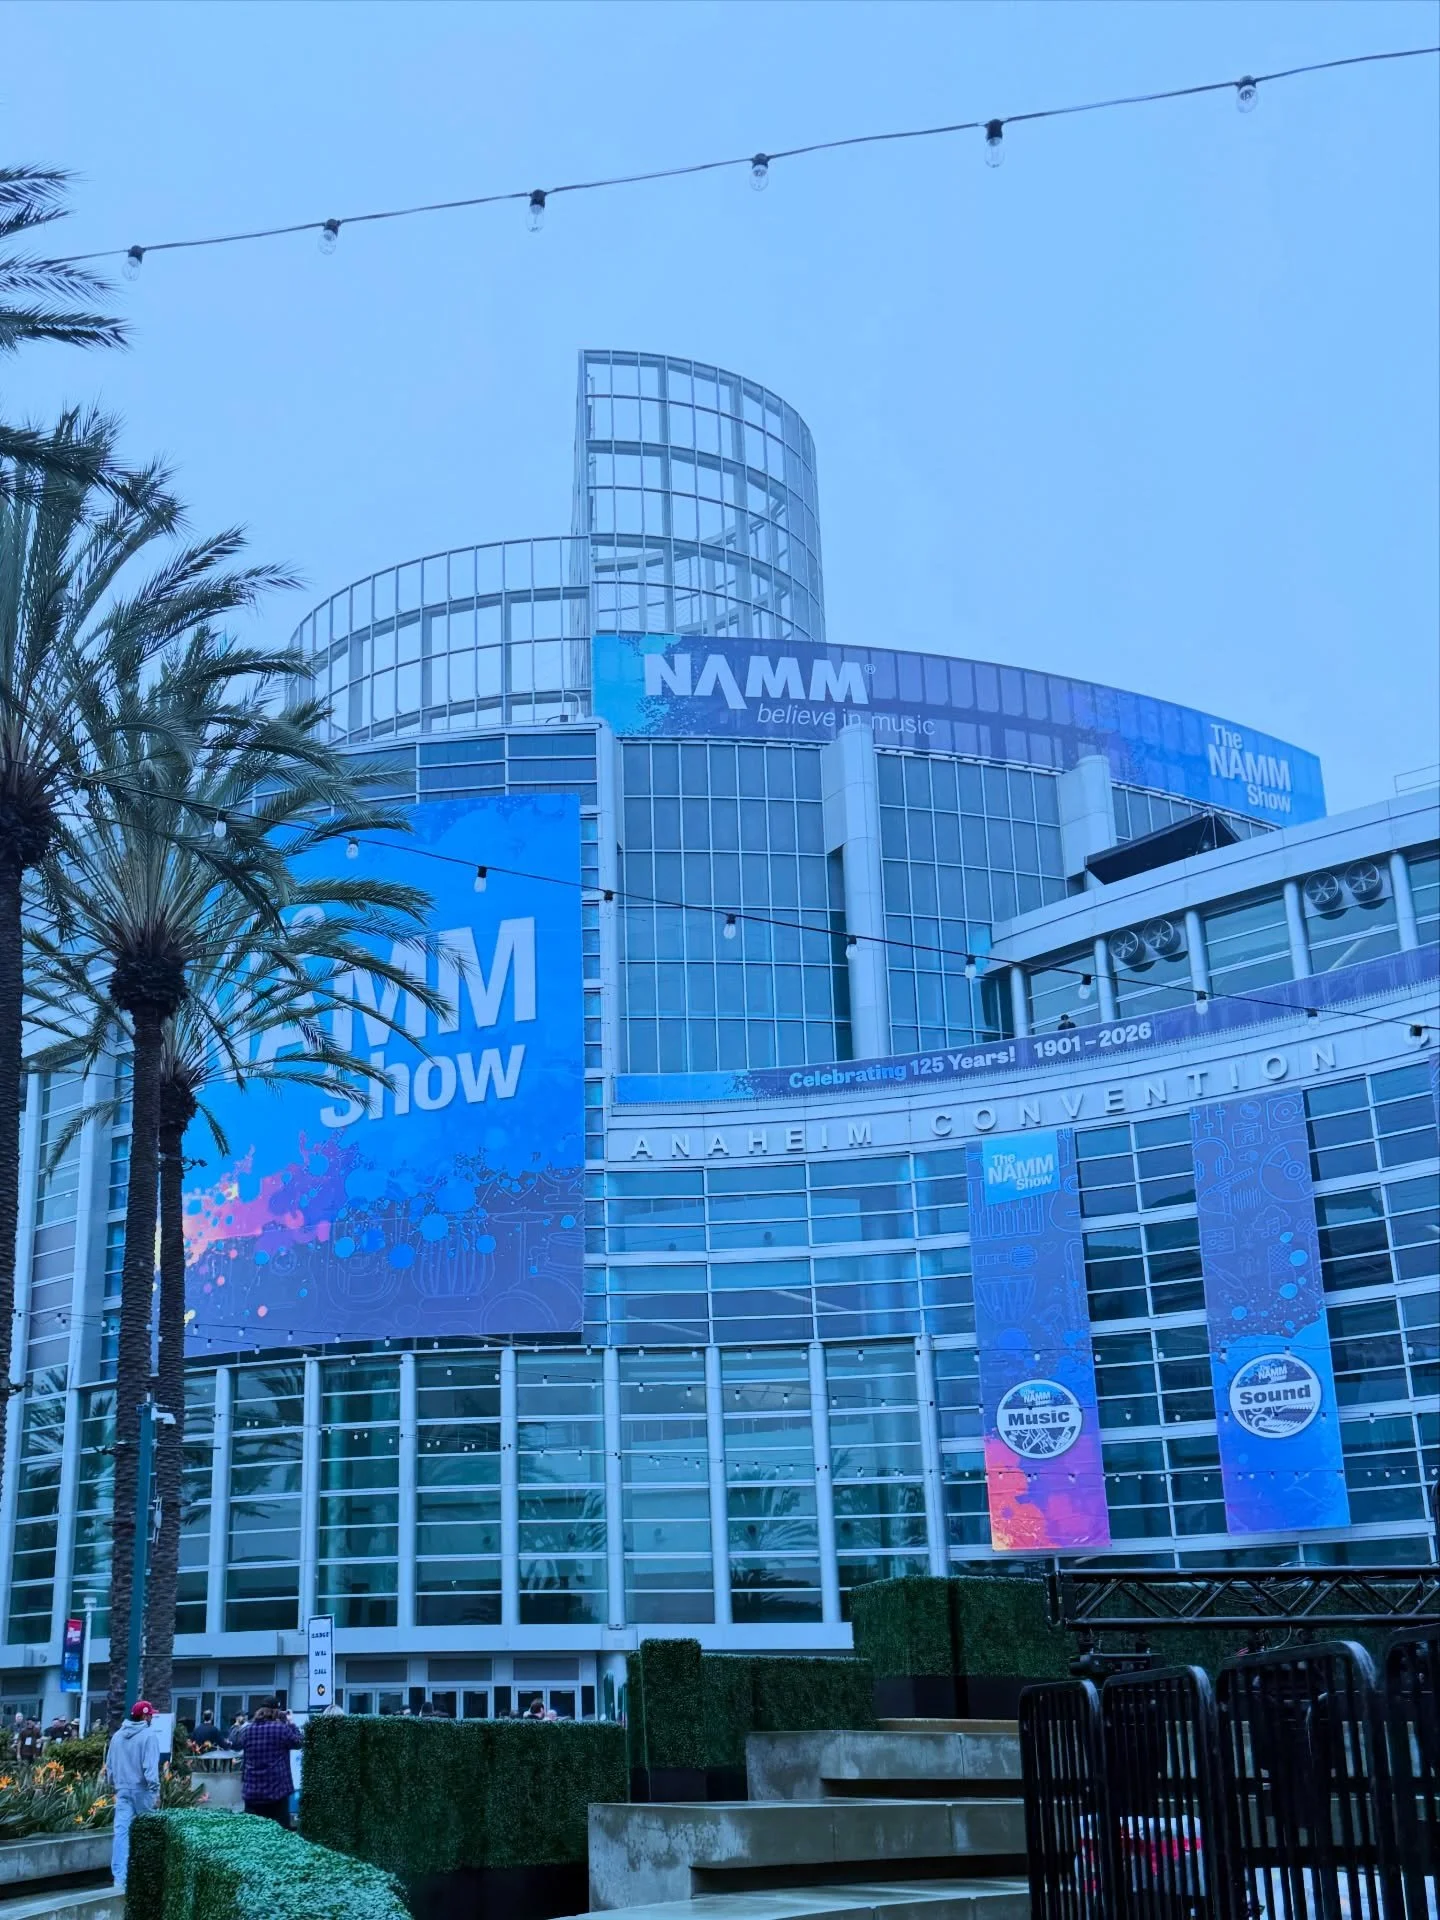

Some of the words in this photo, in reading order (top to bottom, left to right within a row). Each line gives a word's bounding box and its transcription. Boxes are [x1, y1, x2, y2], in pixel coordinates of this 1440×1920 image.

[757, 703, 836, 727] believe
[871, 714, 936, 736] music
[1210, 723, 1243, 750] The
[1208, 743, 1292, 792] NAMM
[1247, 784, 1292, 814] Show
[789, 1063, 907, 1090] Celebrating
[911, 1057, 945, 1076] 125
[949, 1050, 1016, 1071] Years!
[1034, 1037, 1082, 1059] 1901
[1099, 1022, 1152, 1048] 2026
[632, 1120, 873, 1159] ANAHEIM
[930, 1042, 1337, 1136] CONVENTION
[988, 1153, 1054, 1185] NAMM
[992, 1153, 1016, 1167] The
[1016, 1174, 1053, 1191] Show
[1239, 1384, 1311, 1405] Sound
[1008, 1409, 1070, 1427] Music
